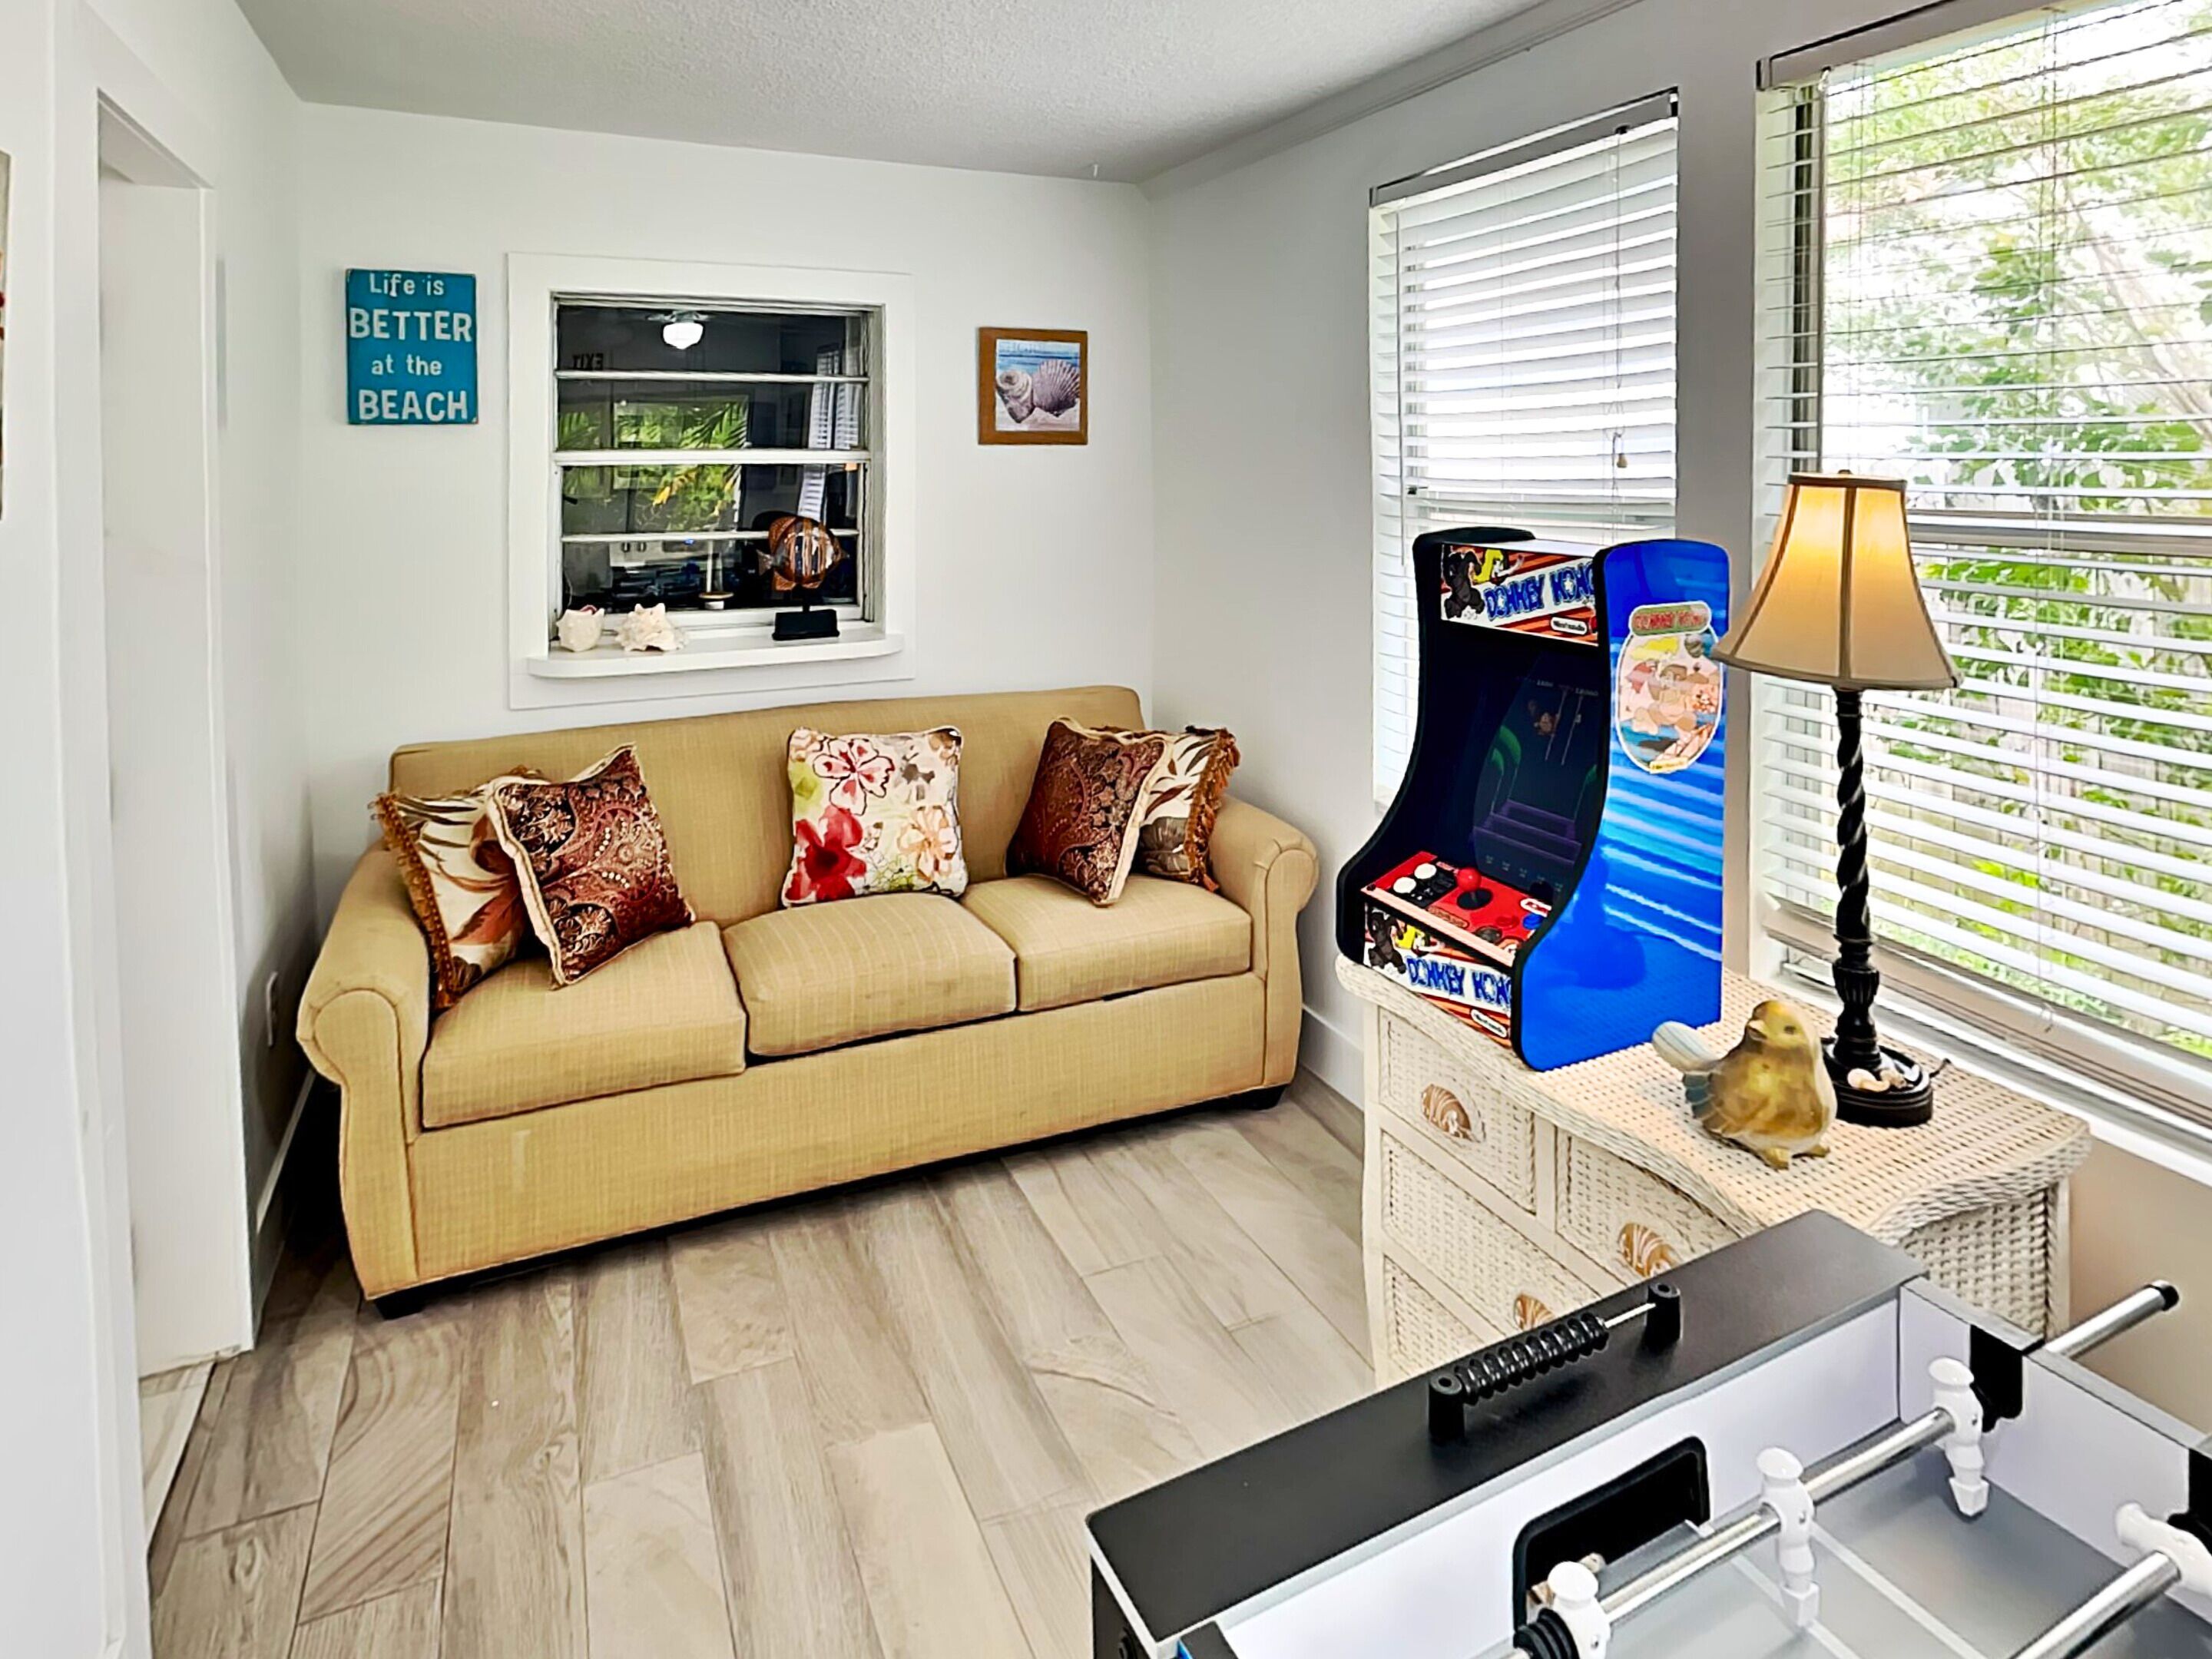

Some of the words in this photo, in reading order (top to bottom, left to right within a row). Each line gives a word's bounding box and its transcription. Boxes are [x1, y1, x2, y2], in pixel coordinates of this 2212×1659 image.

[369, 273, 416, 297] Life
[426, 274, 445, 296] is
[349, 307, 472, 343] BETTER
[371, 354, 395, 375] at
[406, 353, 442, 376] the
[359, 389, 468, 422] BEACH
[1483, 575, 1545, 621] DONKEY
[1406, 956, 1465, 997] DONKEY
[1470, 969, 1511, 1008] KON
